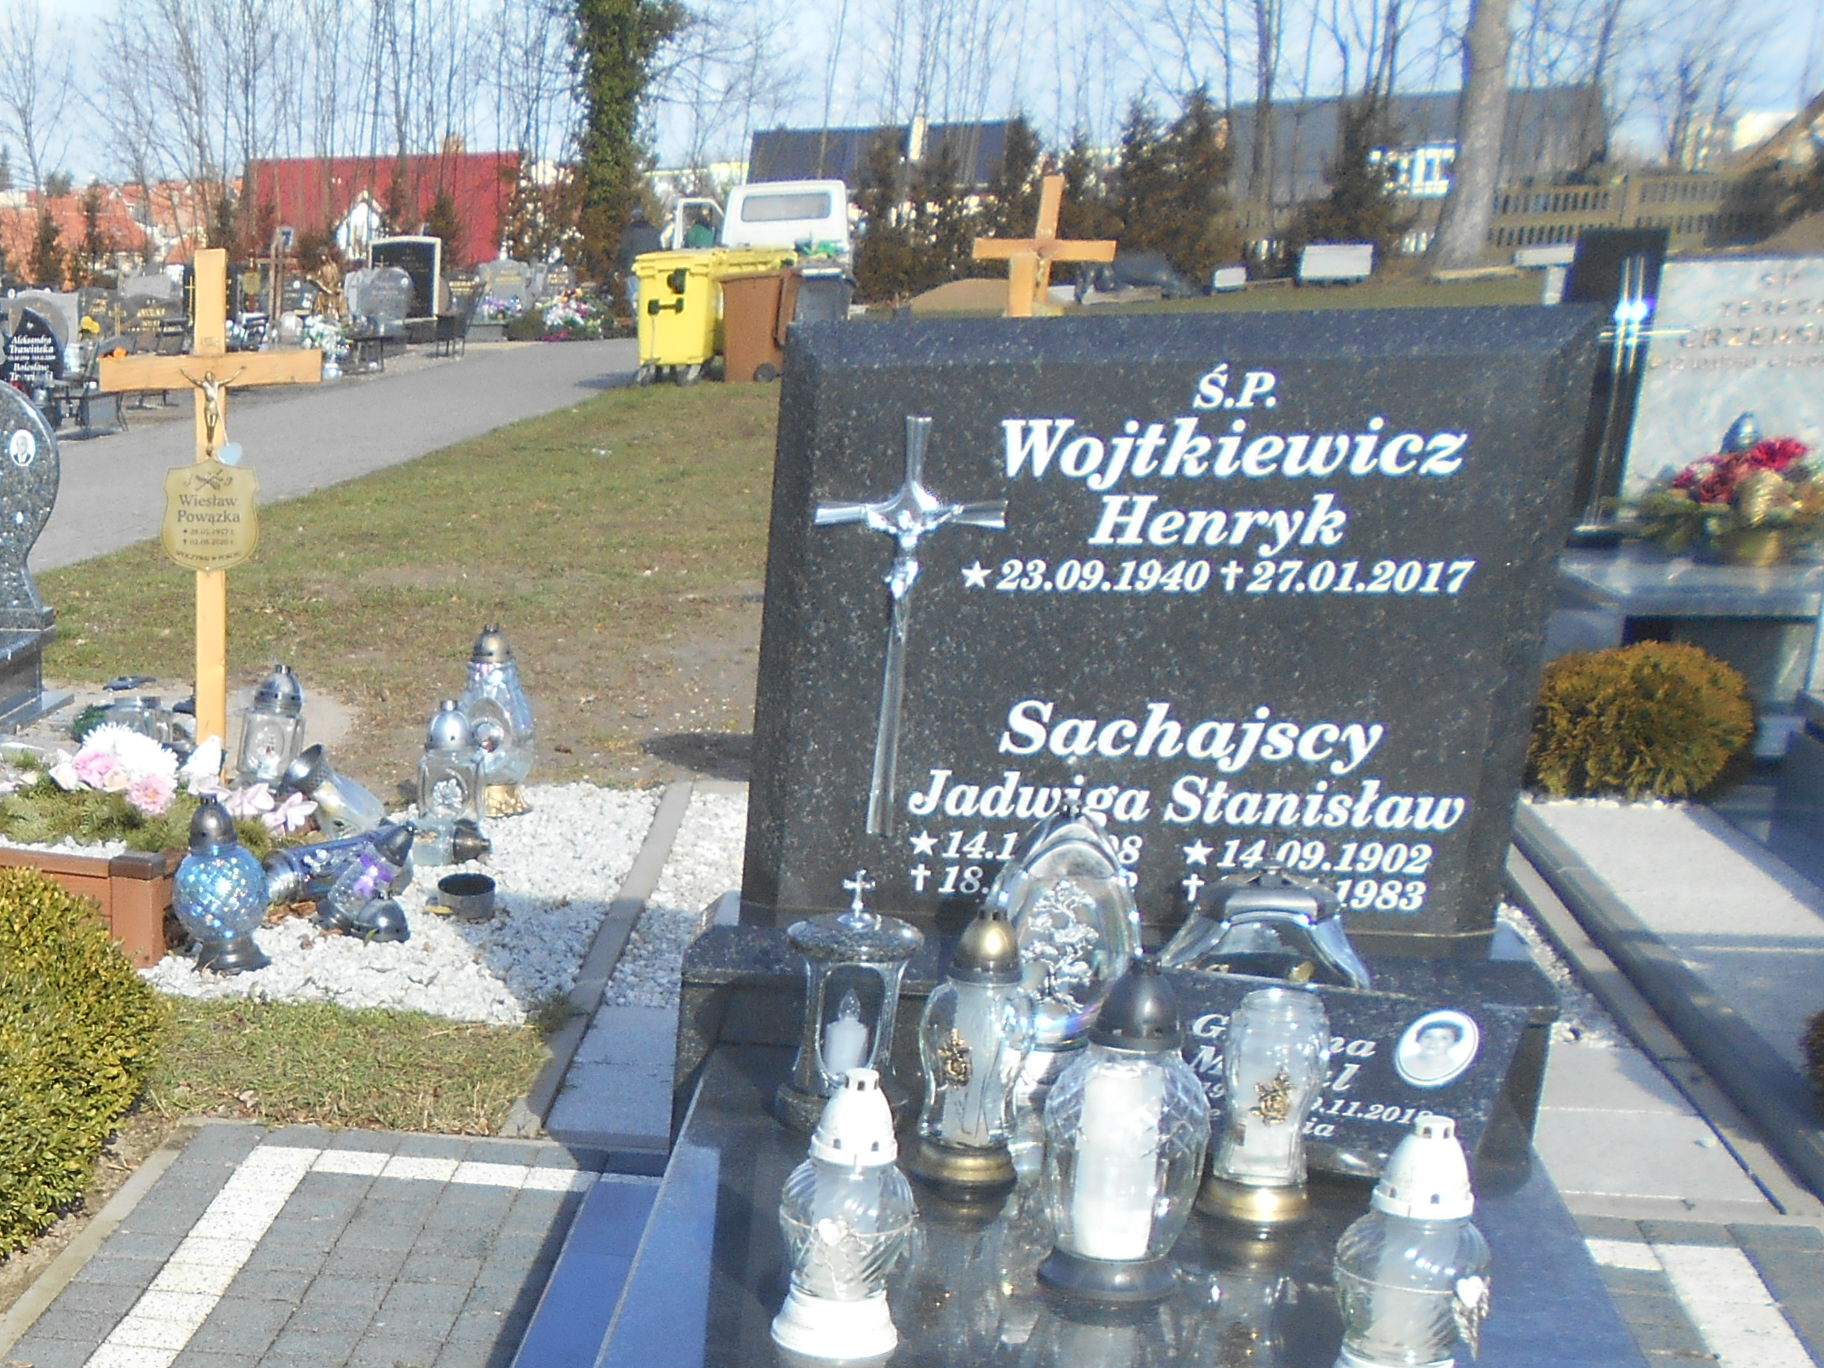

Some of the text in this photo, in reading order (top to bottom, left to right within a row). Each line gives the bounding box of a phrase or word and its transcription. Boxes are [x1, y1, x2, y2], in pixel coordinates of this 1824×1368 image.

[1193, 364, 1278, 410] Ś.P.
[1001, 416, 1468, 490] Wojtkiewicz
[177, 510, 240, 526] Powązka
[178, 494, 237, 507] Wiesław
[1089, 493, 1350, 558] Henryk
[996, 558, 1476, 594] 23.09.1940 27.01.2017
[998, 699, 1384, 774] Sachajscy
[908, 769, 1467, 832] Jadwiga Stanisław
[1216, 839, 1433, 874] 1409.1902
